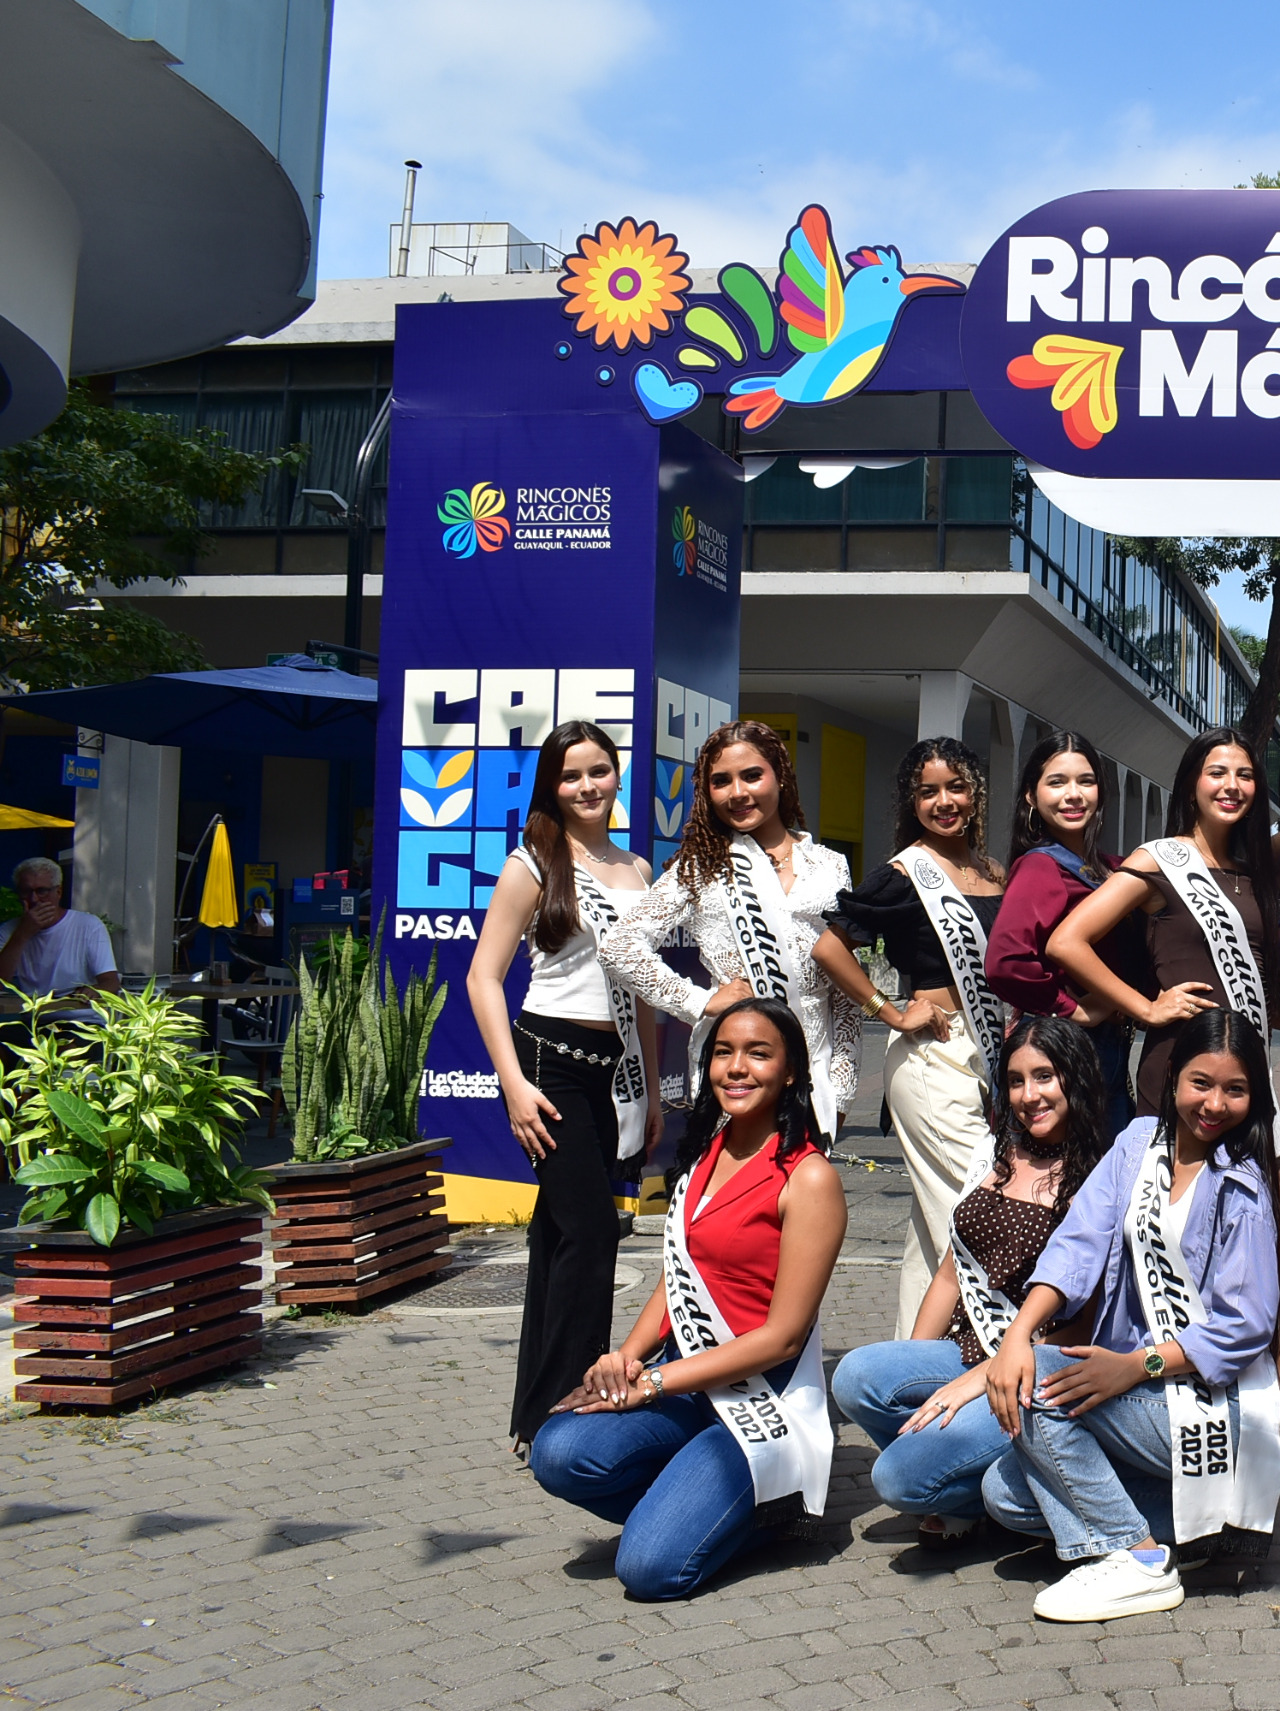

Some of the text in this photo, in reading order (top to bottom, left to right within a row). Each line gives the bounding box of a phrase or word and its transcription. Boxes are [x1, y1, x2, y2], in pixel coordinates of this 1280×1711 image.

[516, 487, 611, 503] RINCONES
[514, 541, 564, 550] GUAYAQUIL
[570, 541, 611, 549] ECUADOR
[515, 526, 610, 539] CALLE PANAMÁ
[395, 914, 477, 940] PASA
[729, 852, 789, 1006] Candida
[1187, 892, 1222, 943] MISS
[736, 916, 768, 996] COLEG
[938, 917, 967, 971] MISS
[1186, 872, 1263, 1032] Candida
[428, 1069, 447, 1085] La
[447, 1069, 499, 1086] Ciudad
[428, 1083, 451, 1098] de
[625, 1054, 644, 1100] 2026
[1136, 1179, 1154, 1243] MISS
[727, 1401, 768, 1444] 2027
[748, 1391, 788, 1440] 2026
[1181, 1424, 1201, 1477] 2027
[1206, 1419, 1228, 1474] 2026
